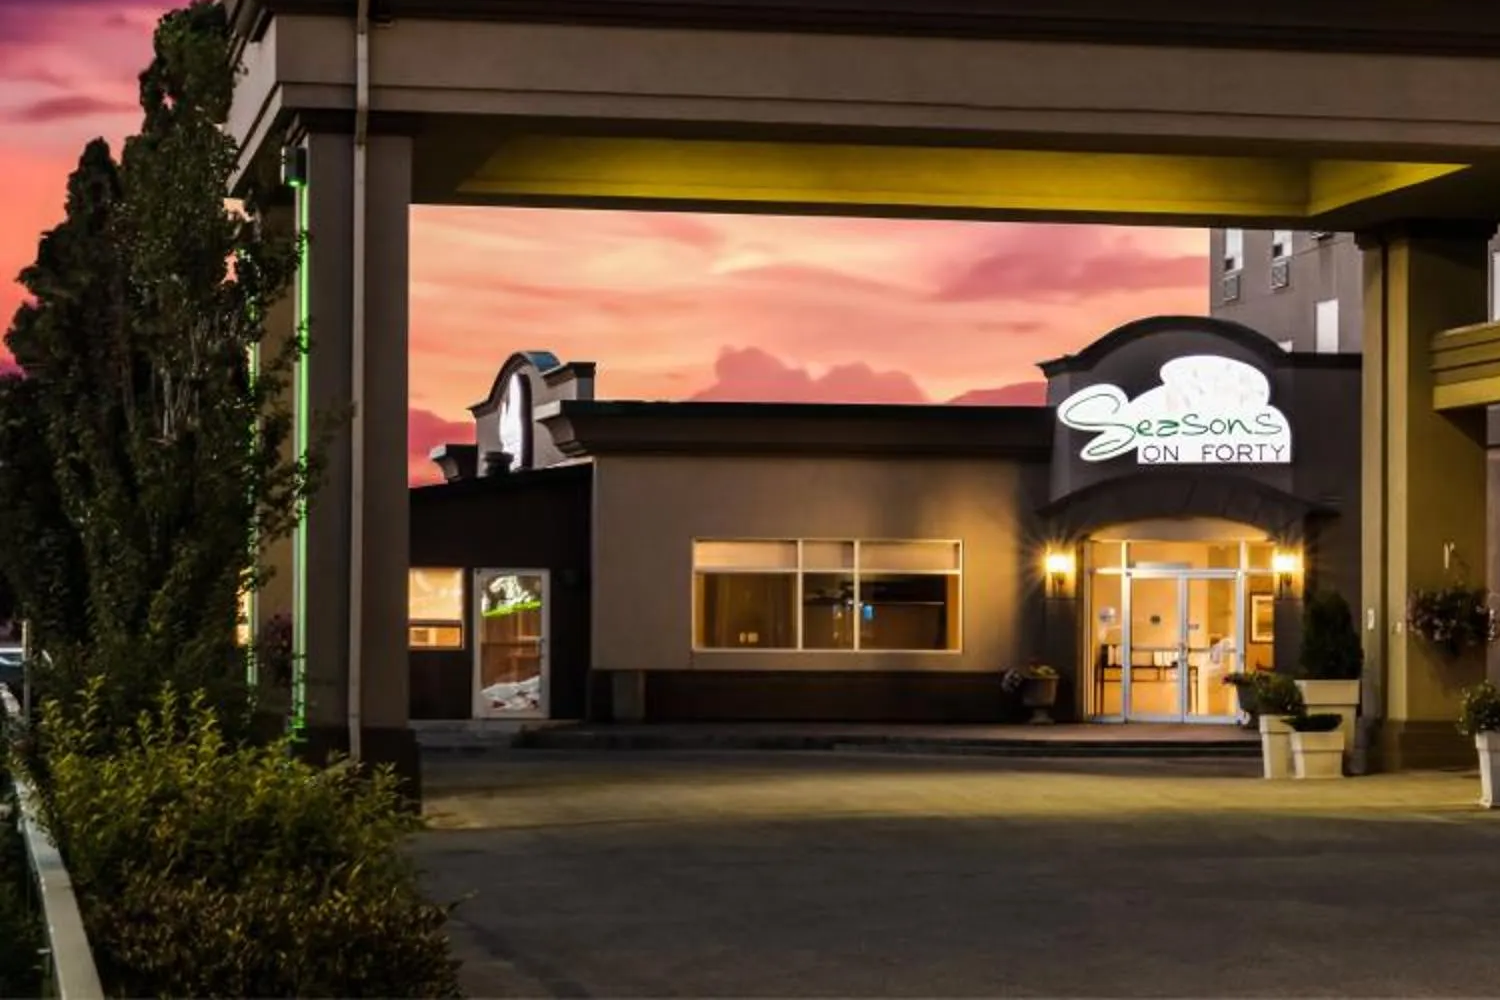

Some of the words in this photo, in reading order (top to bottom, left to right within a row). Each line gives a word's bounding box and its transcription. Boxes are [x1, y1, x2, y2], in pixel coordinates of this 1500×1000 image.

[1064, 393, 1283, 457] Seasons
[1142, 444, 1179, 462] ON
[1201, 443, 1286, 462] FORTY
